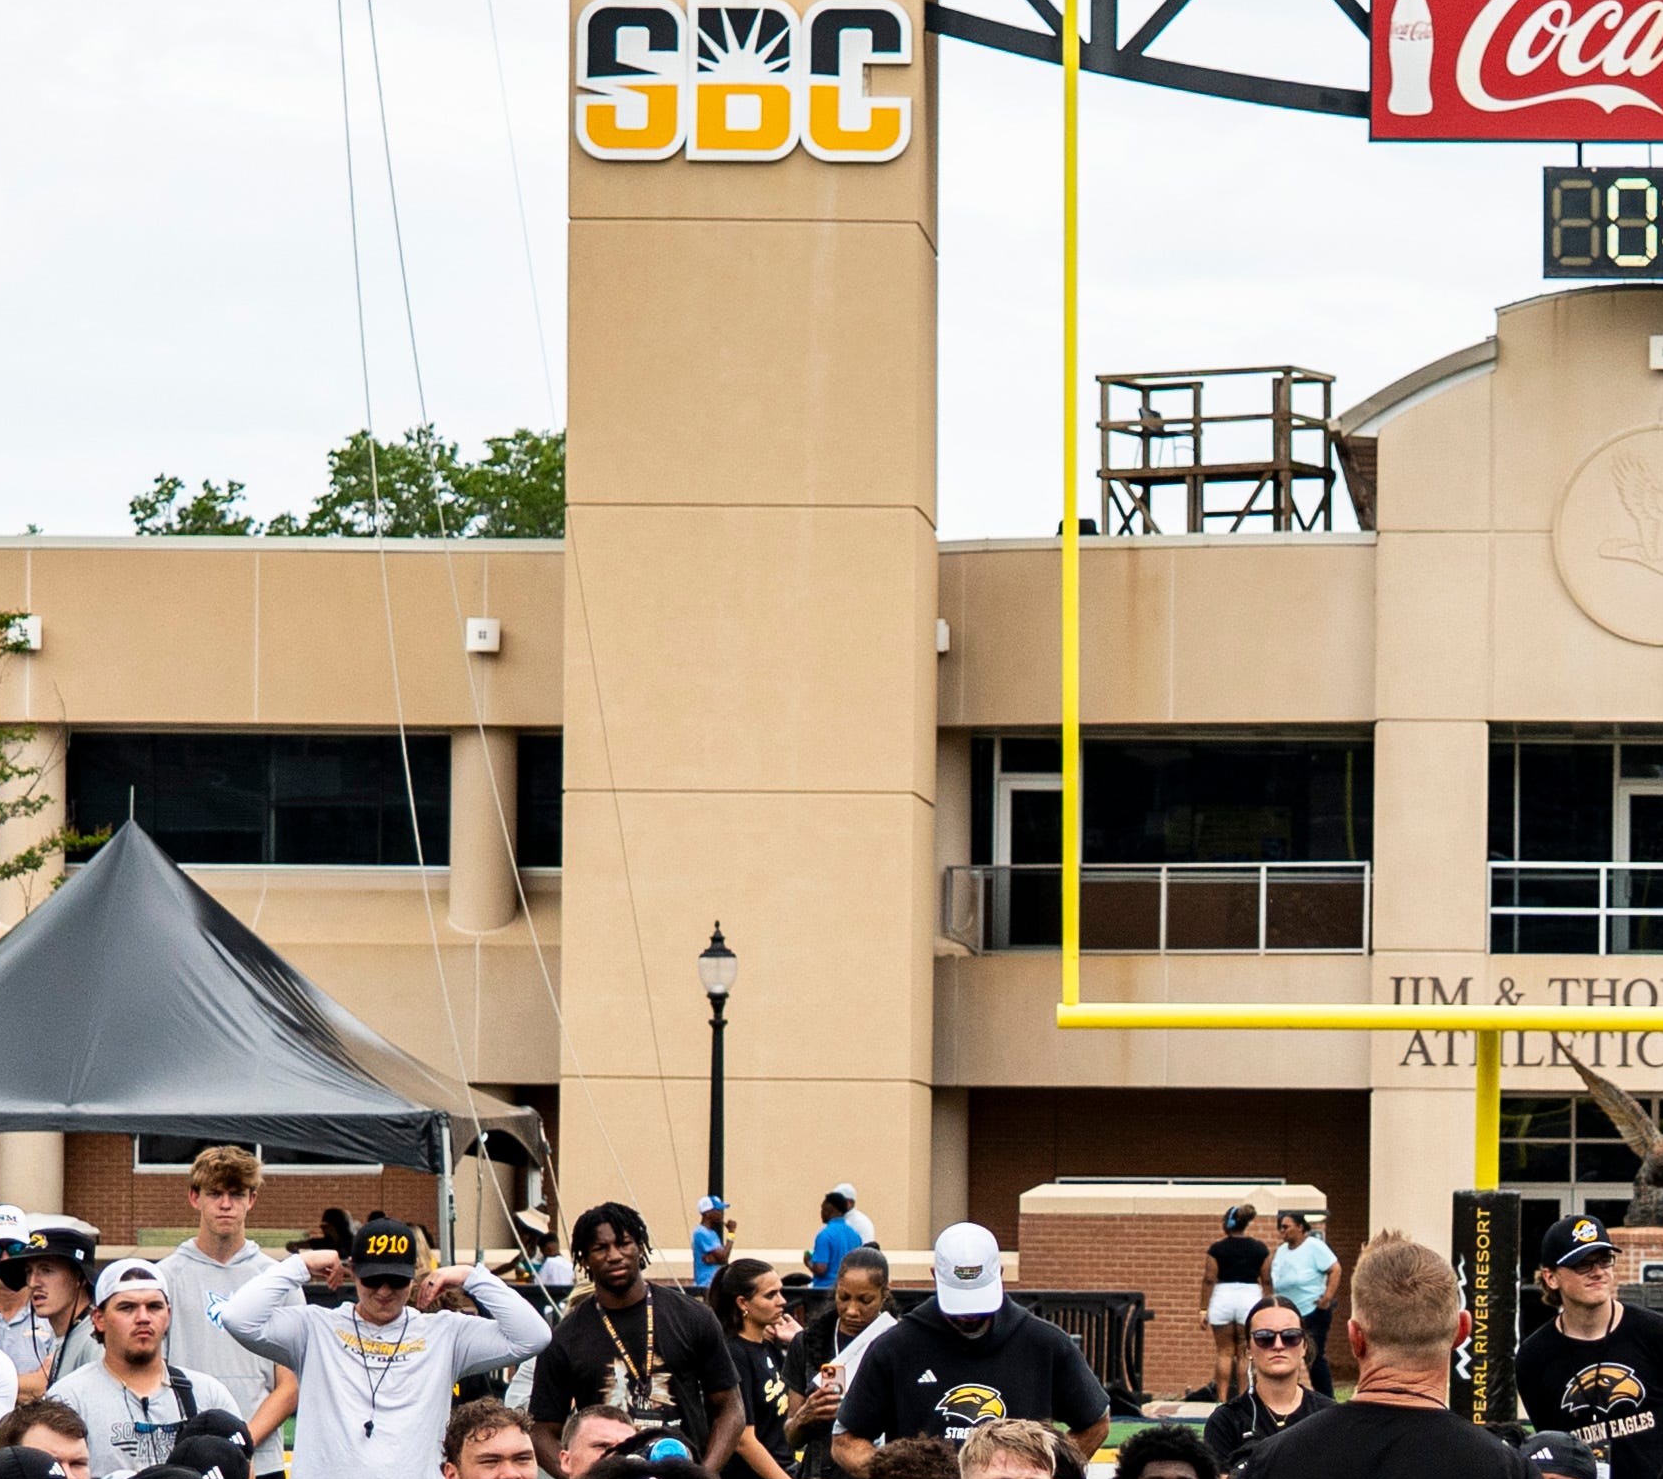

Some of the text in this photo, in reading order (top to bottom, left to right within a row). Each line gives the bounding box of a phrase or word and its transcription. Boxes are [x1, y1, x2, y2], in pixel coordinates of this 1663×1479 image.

[366, 1233, 410, 1256] 1910
[1472, 1207, 1491, 1425] PEARL RIVER RESORT
[1609, 1410, 1656, 1438] EAGLES
